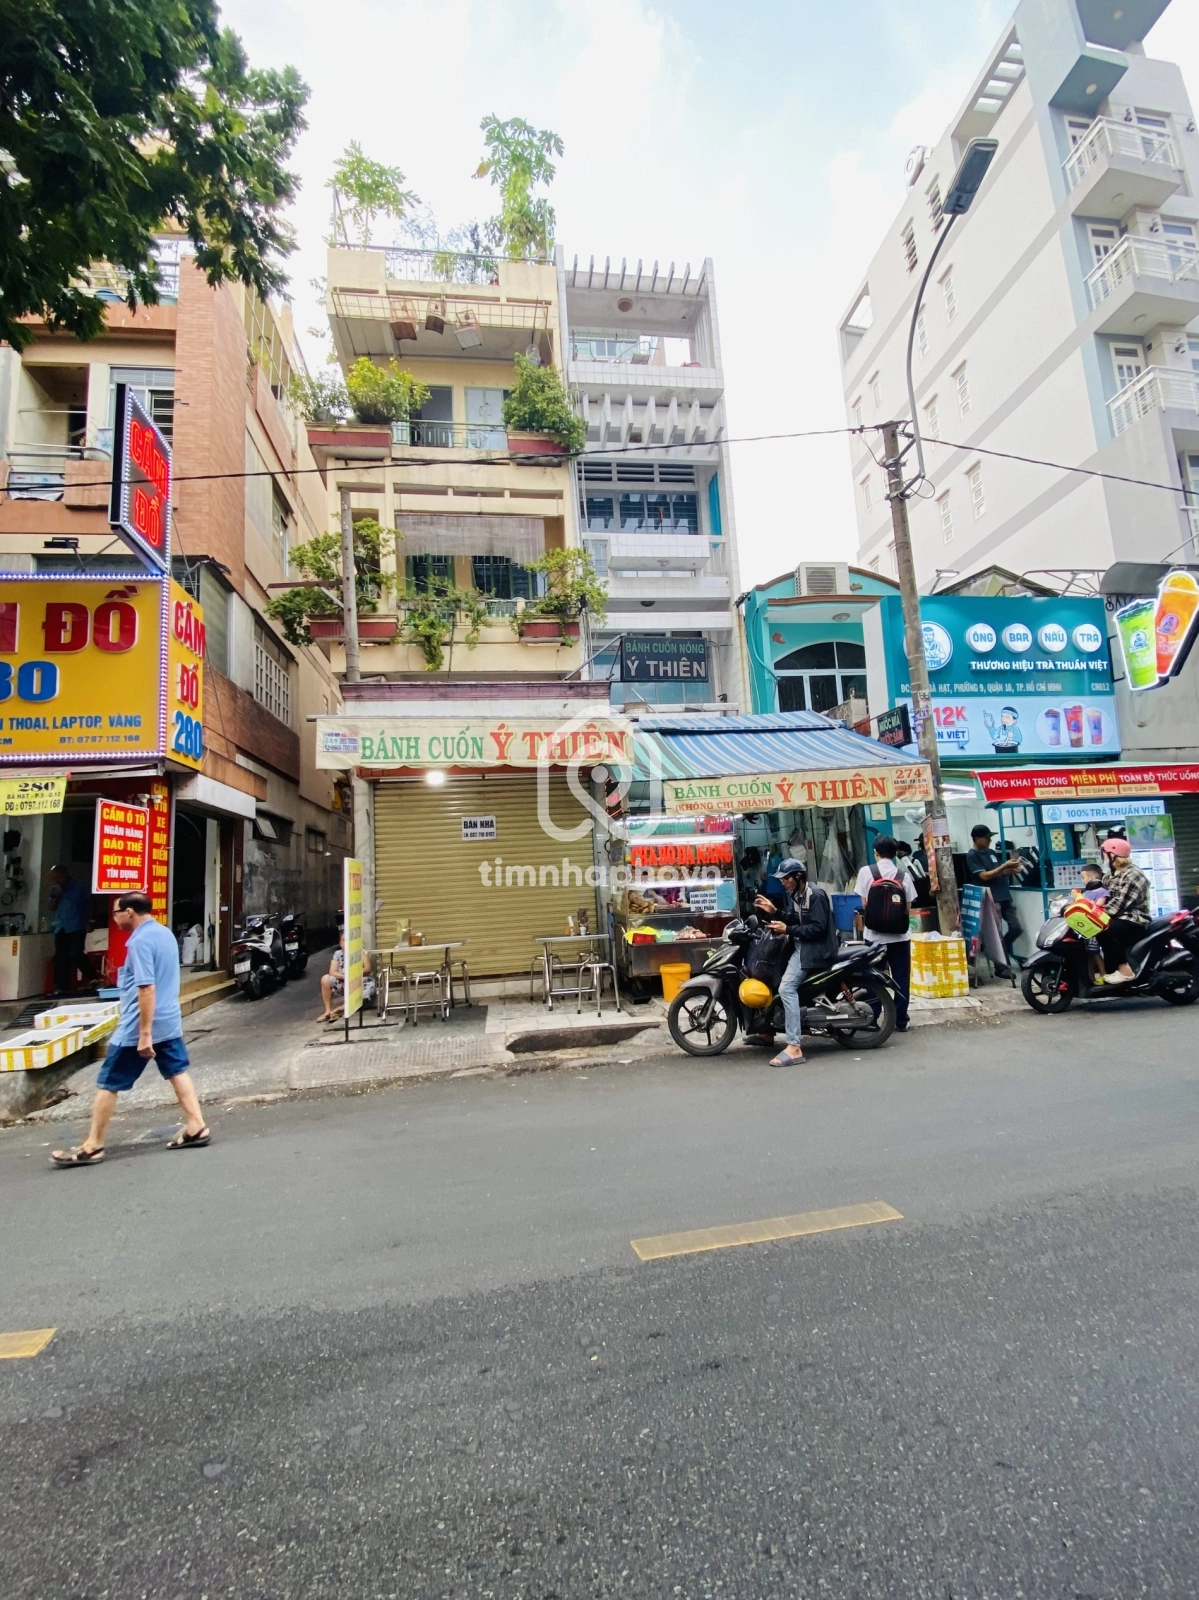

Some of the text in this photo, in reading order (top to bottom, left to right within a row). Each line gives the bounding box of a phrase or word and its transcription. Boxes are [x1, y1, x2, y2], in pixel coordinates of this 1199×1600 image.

[43, 585, 139, 653] ĐỒ
[973, 631, 994, 643] ÔNG
[1009, 632, 1030, 643] BAR
[1080, 630, 1099, 643] TRÀ
[625, 640, 704, 654] BÁNH CUỐN NÓNG
[626, 656, 706, 677] Ý THIÊN
[970, 660, 1010, 670] THƯƠNG
[1012, 660, 1034, 672] HIỆU
[1036, 659, 1055, 670] TRÀ
[1087, 660, 1108, 671] VIỆT
[177, 663, 199, 709] ĐỒ
[108, 713, 142, 728] VÀNG
[173, 711, 203, 760] 280
[946, 729, 967, 739] VIỆT
[360, 723, 626, 760] BÁNH CUỐN Ý THIÊN
[895, 768, 922, 779] 274
[982, 778, 1008, 788] MỪNG
[1010, 778, 1031, 787] KHAI
[1070, 769, 1096, 785] MIỄN
[1098, 771, 1117, 784] PHÍ
[1118, 773, 1142, 783] TOÀN
[1156, 771, 1178, 781] THỨC
[18, 781, 56, 792] 280
[673, 772, 887, 804] BÁNH CUỐN Ý THIÊN
[675, 802, 714, 811] (KHÔNG
[716, 801, 734, 809] CHI
[1066, 809, 1089, 818] 100%
[1090, 807, 1107, 817] TRÀ
[135, 813, 146, 826] TÔ
[156, 816, 166, 828] XE
[463, 819, 495, 829] BÁN NHÀ
[104, 824, 143, 839] NGÂN HÀNG
[103, 853, 123, 865] RÚT
[106, 867, 118, 878] TÍN
